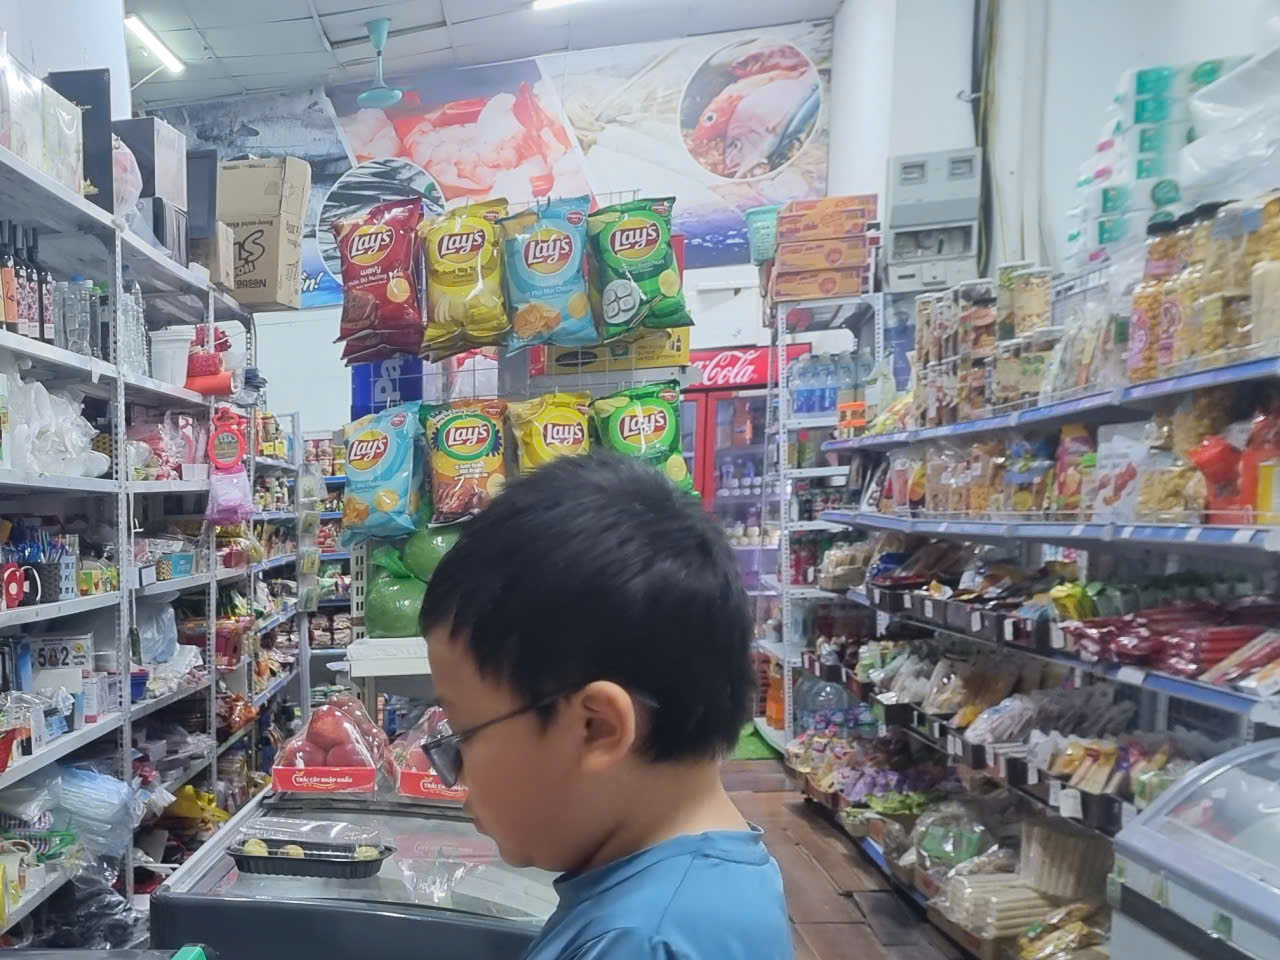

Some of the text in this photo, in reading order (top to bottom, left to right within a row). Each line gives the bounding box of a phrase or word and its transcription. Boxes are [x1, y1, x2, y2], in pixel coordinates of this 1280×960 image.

[350, 230, 393, 257] Lay's
[440, 231, 484, 256] Lay's
[614, 224, 657, 252] Lay's
[528, 238, 570, 265] Lay's
[448, 423, 489, 446] Lay's
[546, 423, 583, 445] Lay's
[622, 410, 666, 436] Lay's
[350, 437, 389, 462] Lay's
[38, 646, 70, 668] 502
